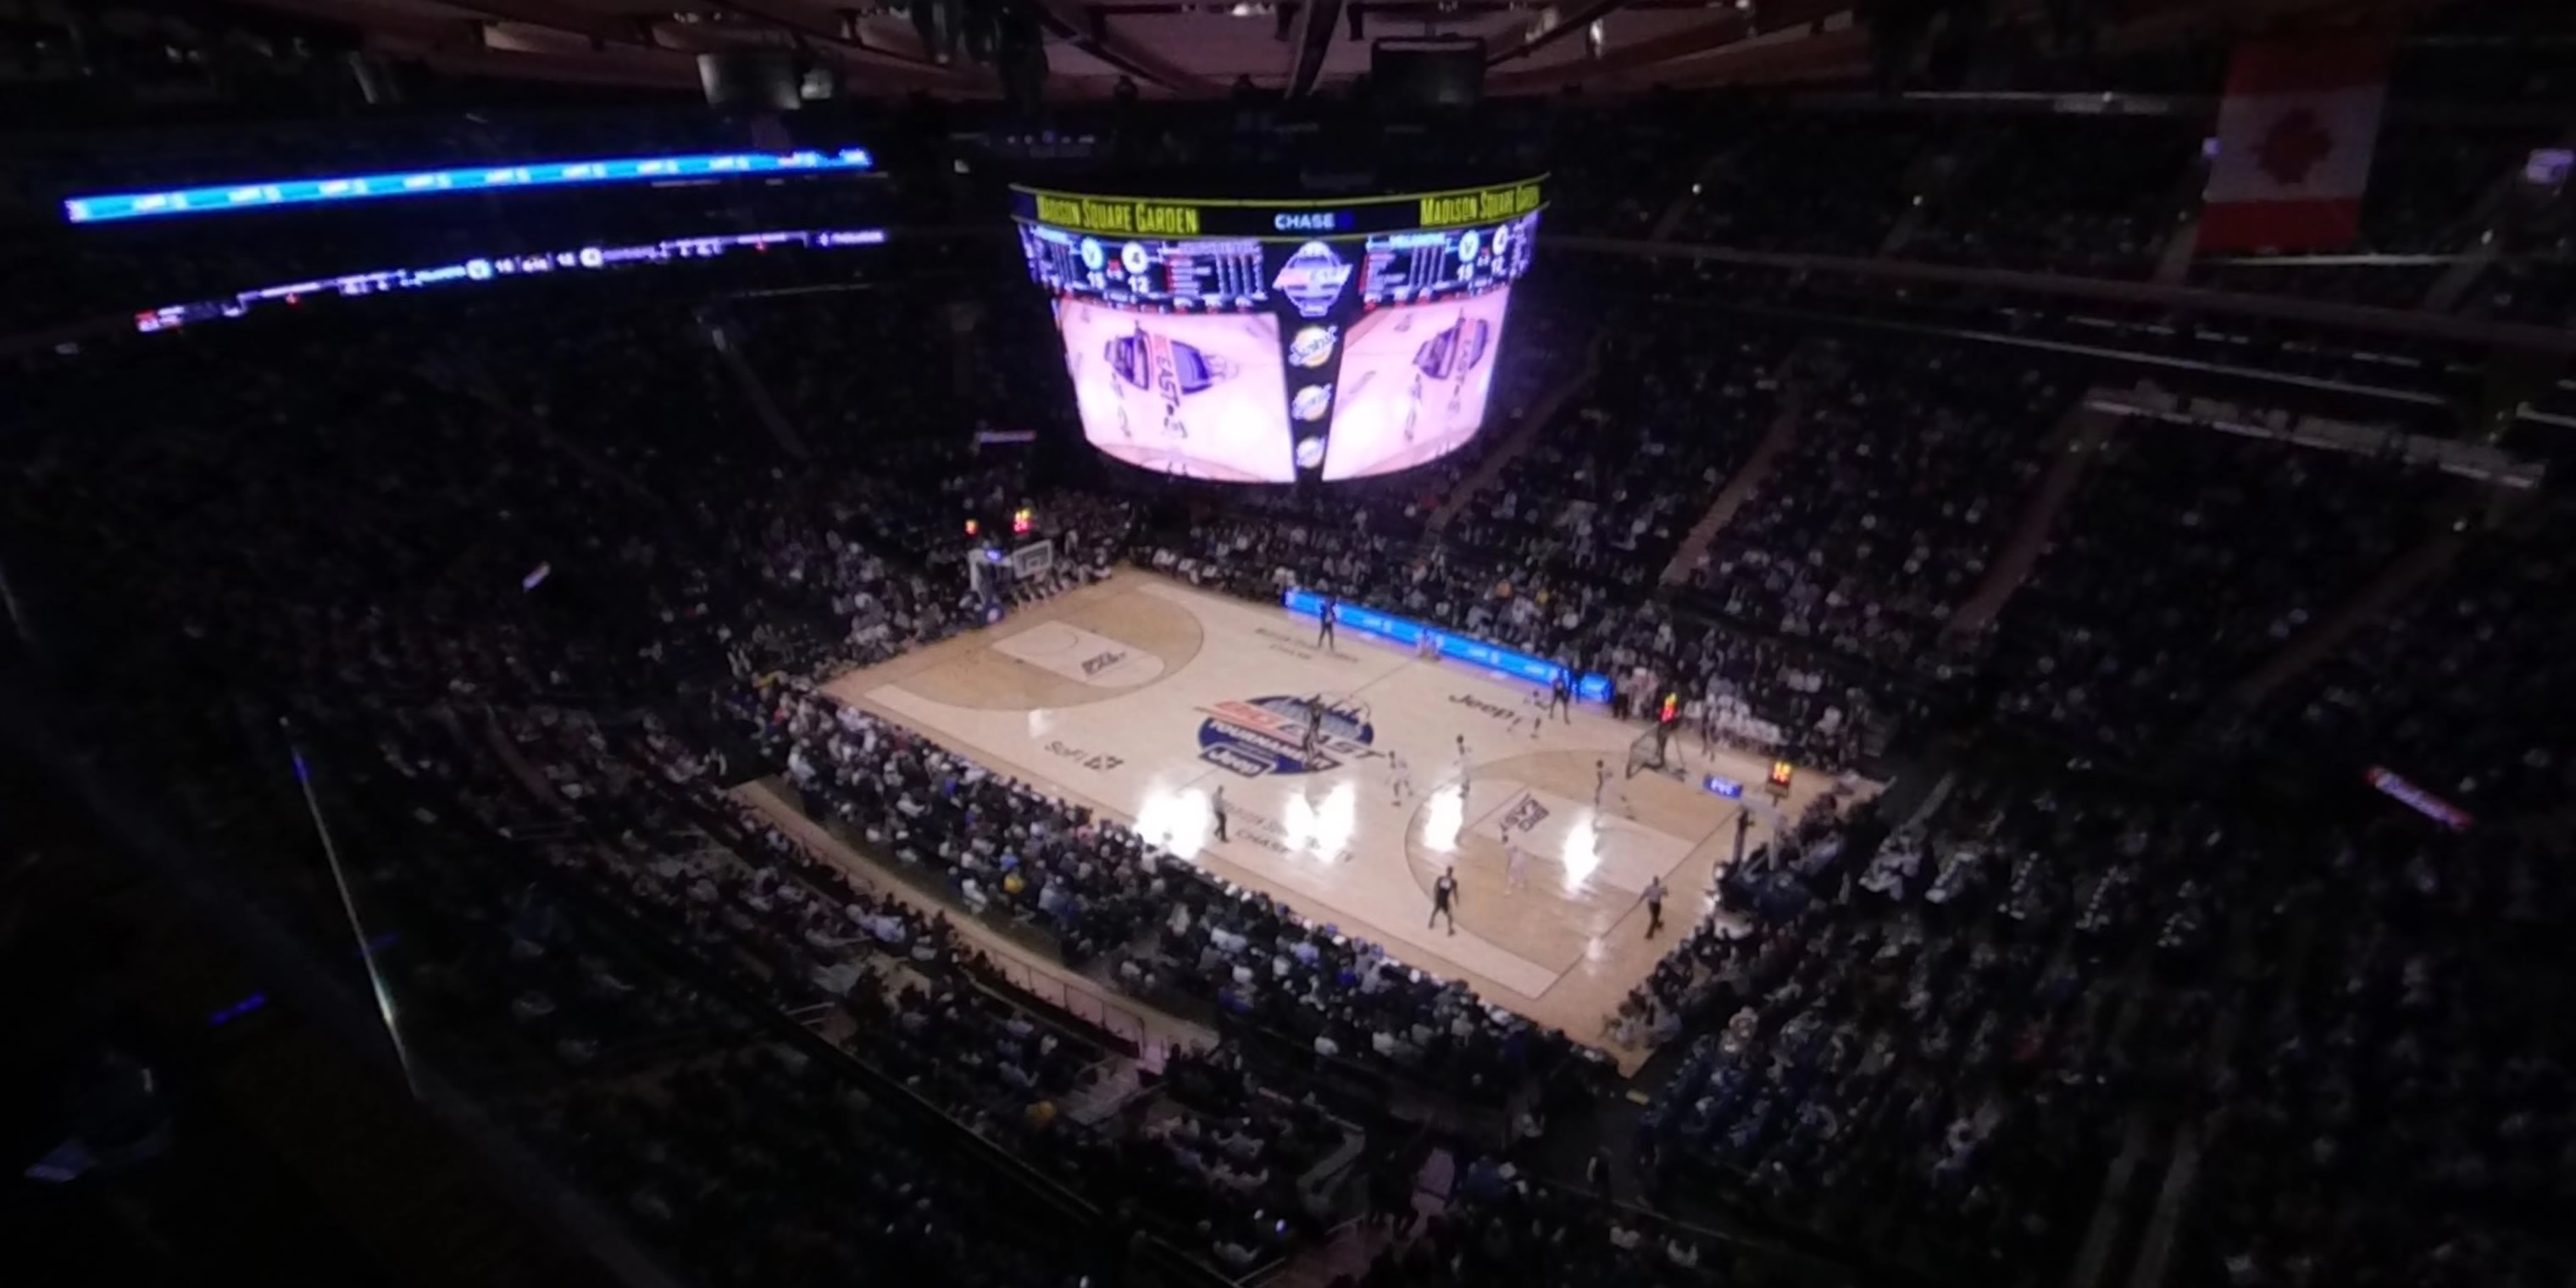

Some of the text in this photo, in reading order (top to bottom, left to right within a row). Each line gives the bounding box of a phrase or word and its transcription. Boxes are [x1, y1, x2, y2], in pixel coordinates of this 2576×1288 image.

[1082, 199, 1131, 230] SQUARE
[1136, 203, 1198, 233] GARDEN
[1274, 213, 1335, 230] CHASE
[1421, 196, 1476, 225] MADISON
[1448, 694, 1515, 719] Jeep
